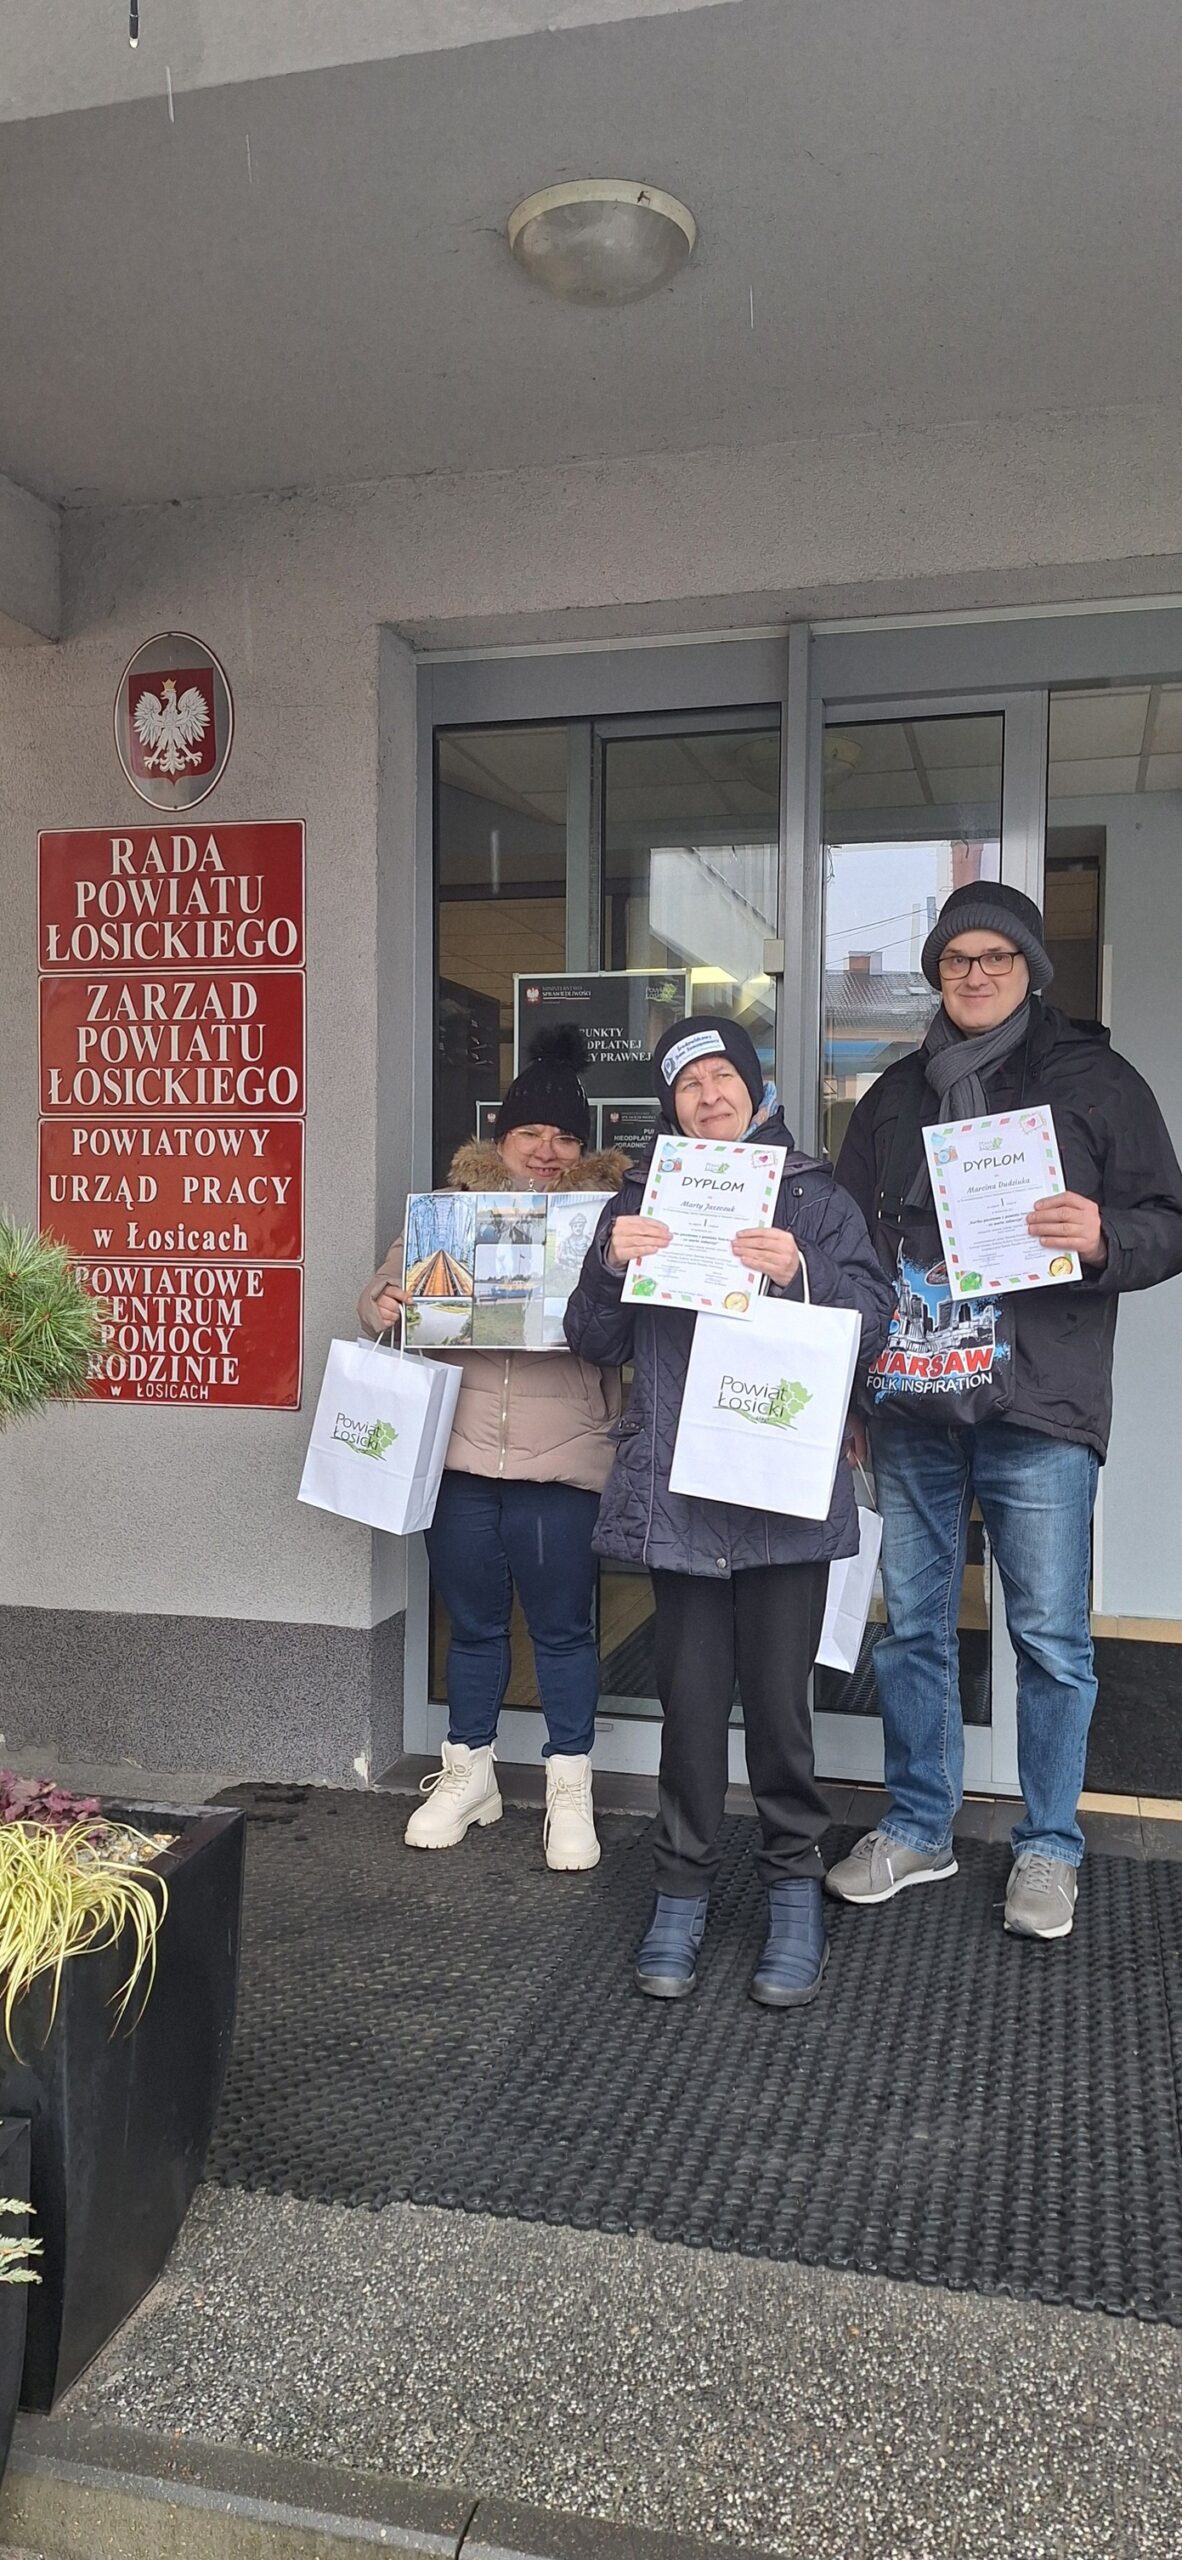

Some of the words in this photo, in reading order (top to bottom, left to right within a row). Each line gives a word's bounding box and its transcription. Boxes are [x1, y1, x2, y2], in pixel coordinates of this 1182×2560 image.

[109, 833, 226, 876] RADA
[74, 875, 265, 919] POWIATU
[46, 917, 298, 962] ŁOSICKIEGO
[76, 1023, 266, 1064] POWIATU
[587, 1039, 642, 1050] DPŁATNEJ
[600, 1051, 652, 1062] PRAWNEJ
[48, 1065, 299, 1106] ŁOSICKIEGO
[72, 1128, 270, 1157] POWIATOWY
[963, 1152, 1025, 1173] DYPLOM
[48, 1175, 158, 1211] URZĄD
[182, 1176, 292, 1205] PRACY
[681, 1176, 745, 1193] DYPLOM
[92, 1228, 114, 1249] w
[126, 1222, 248, 1251] Łosicach
[101, 1324, 236, 1355] POMOCY
[86, 1352, 240, 1385] RODZINIE
[868, 1347, 994, 1380] WARSAW
[136, 1383, 209, 1400] ŁOSICACH
[720, 1375, 788, 1402] Powiat
[866, 1375, 898, 1390] FOLK
[901, 1372, 993, 1394] INSPIRATION
[717, 1391, 786, 1418] Łosicki
[333, 1425, 379, 1451] Łosicki
[335, 1412, 382, 1438] Powiat
